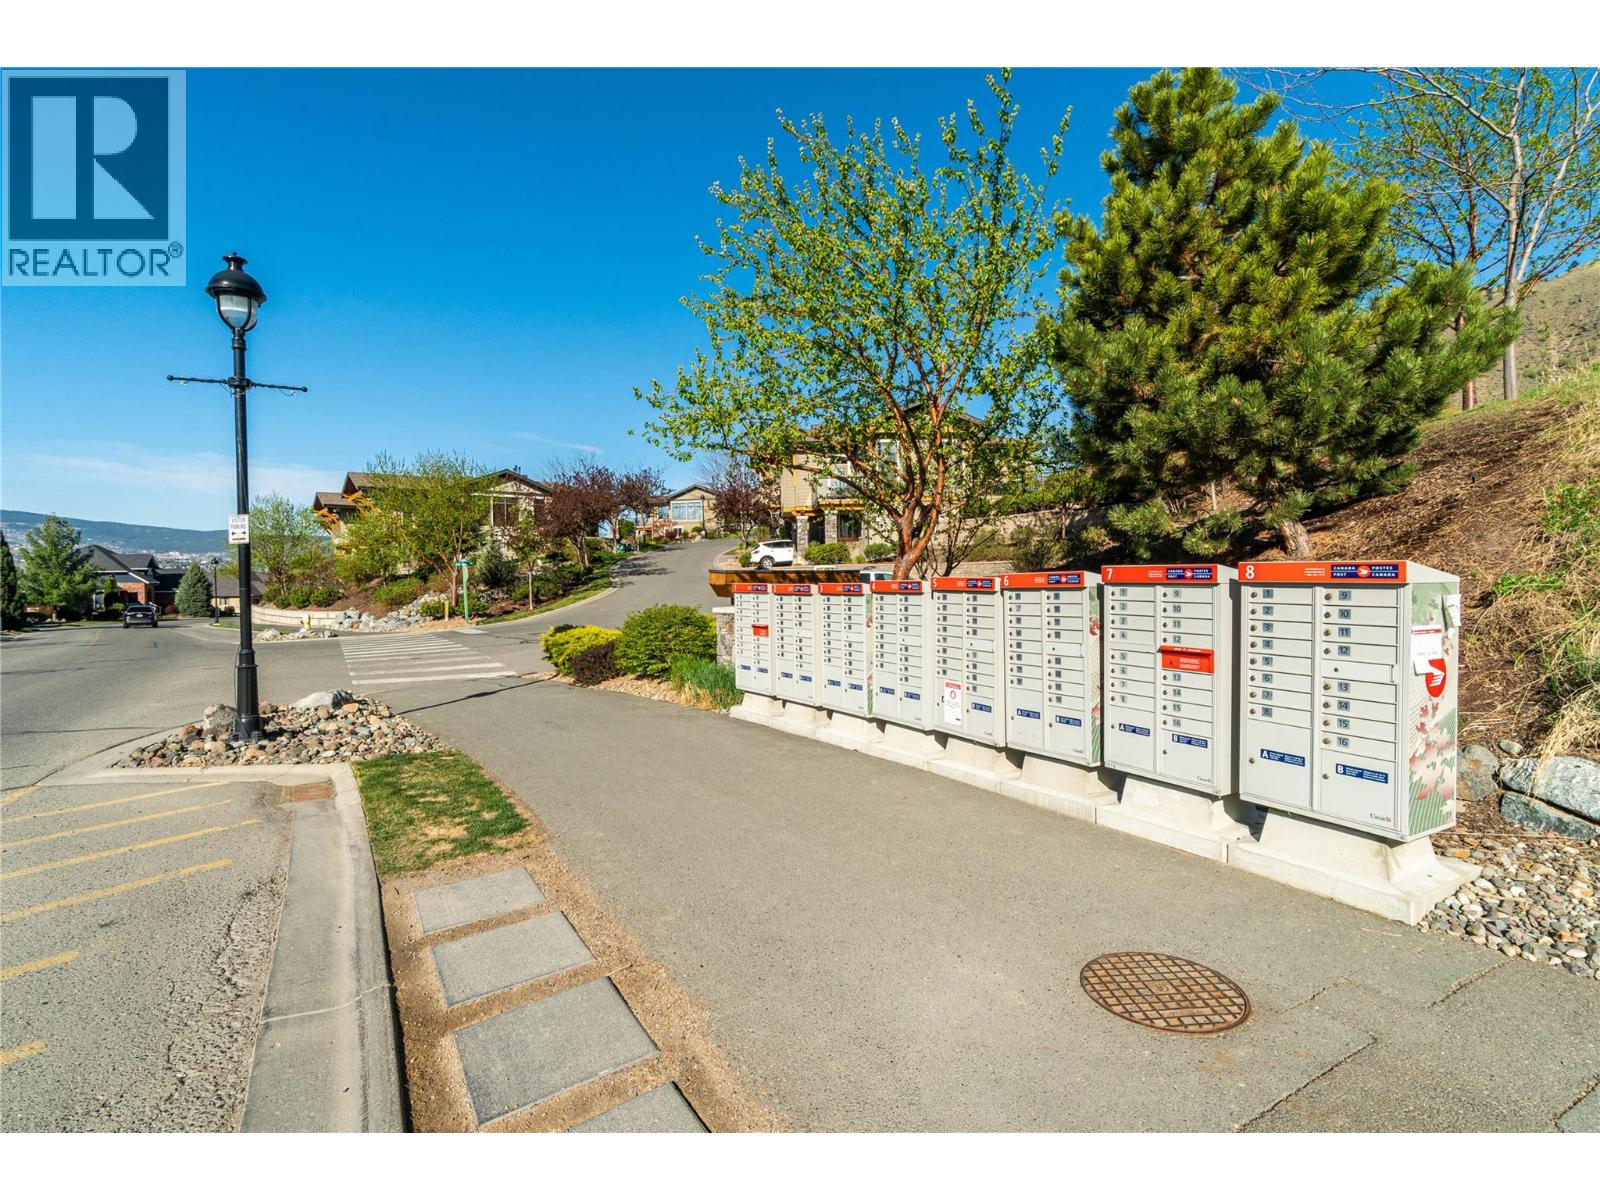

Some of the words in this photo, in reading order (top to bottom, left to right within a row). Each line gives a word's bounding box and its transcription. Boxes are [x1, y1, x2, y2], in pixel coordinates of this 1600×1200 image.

[1106, 568, 1113, 581] 7
[1245, 565, 1255, 579] 8
[932, 579, 937, 588] 5
[1003, 576, 1009, 586] 6
[1341, 591, 1348, 600] 9
[1340, 628, 1349, 636] 11
[1340, 646, 1349, 654] 12
[1339, 683, 1348, 692] 13
[1339, 702, 1348, 710] 14
[1339, 719, 1348, 728] 15
[1338, 738, 1348, 746] 16
[1262, 750, 1269, 759] A
[1337, 765, 1344, 774] B
